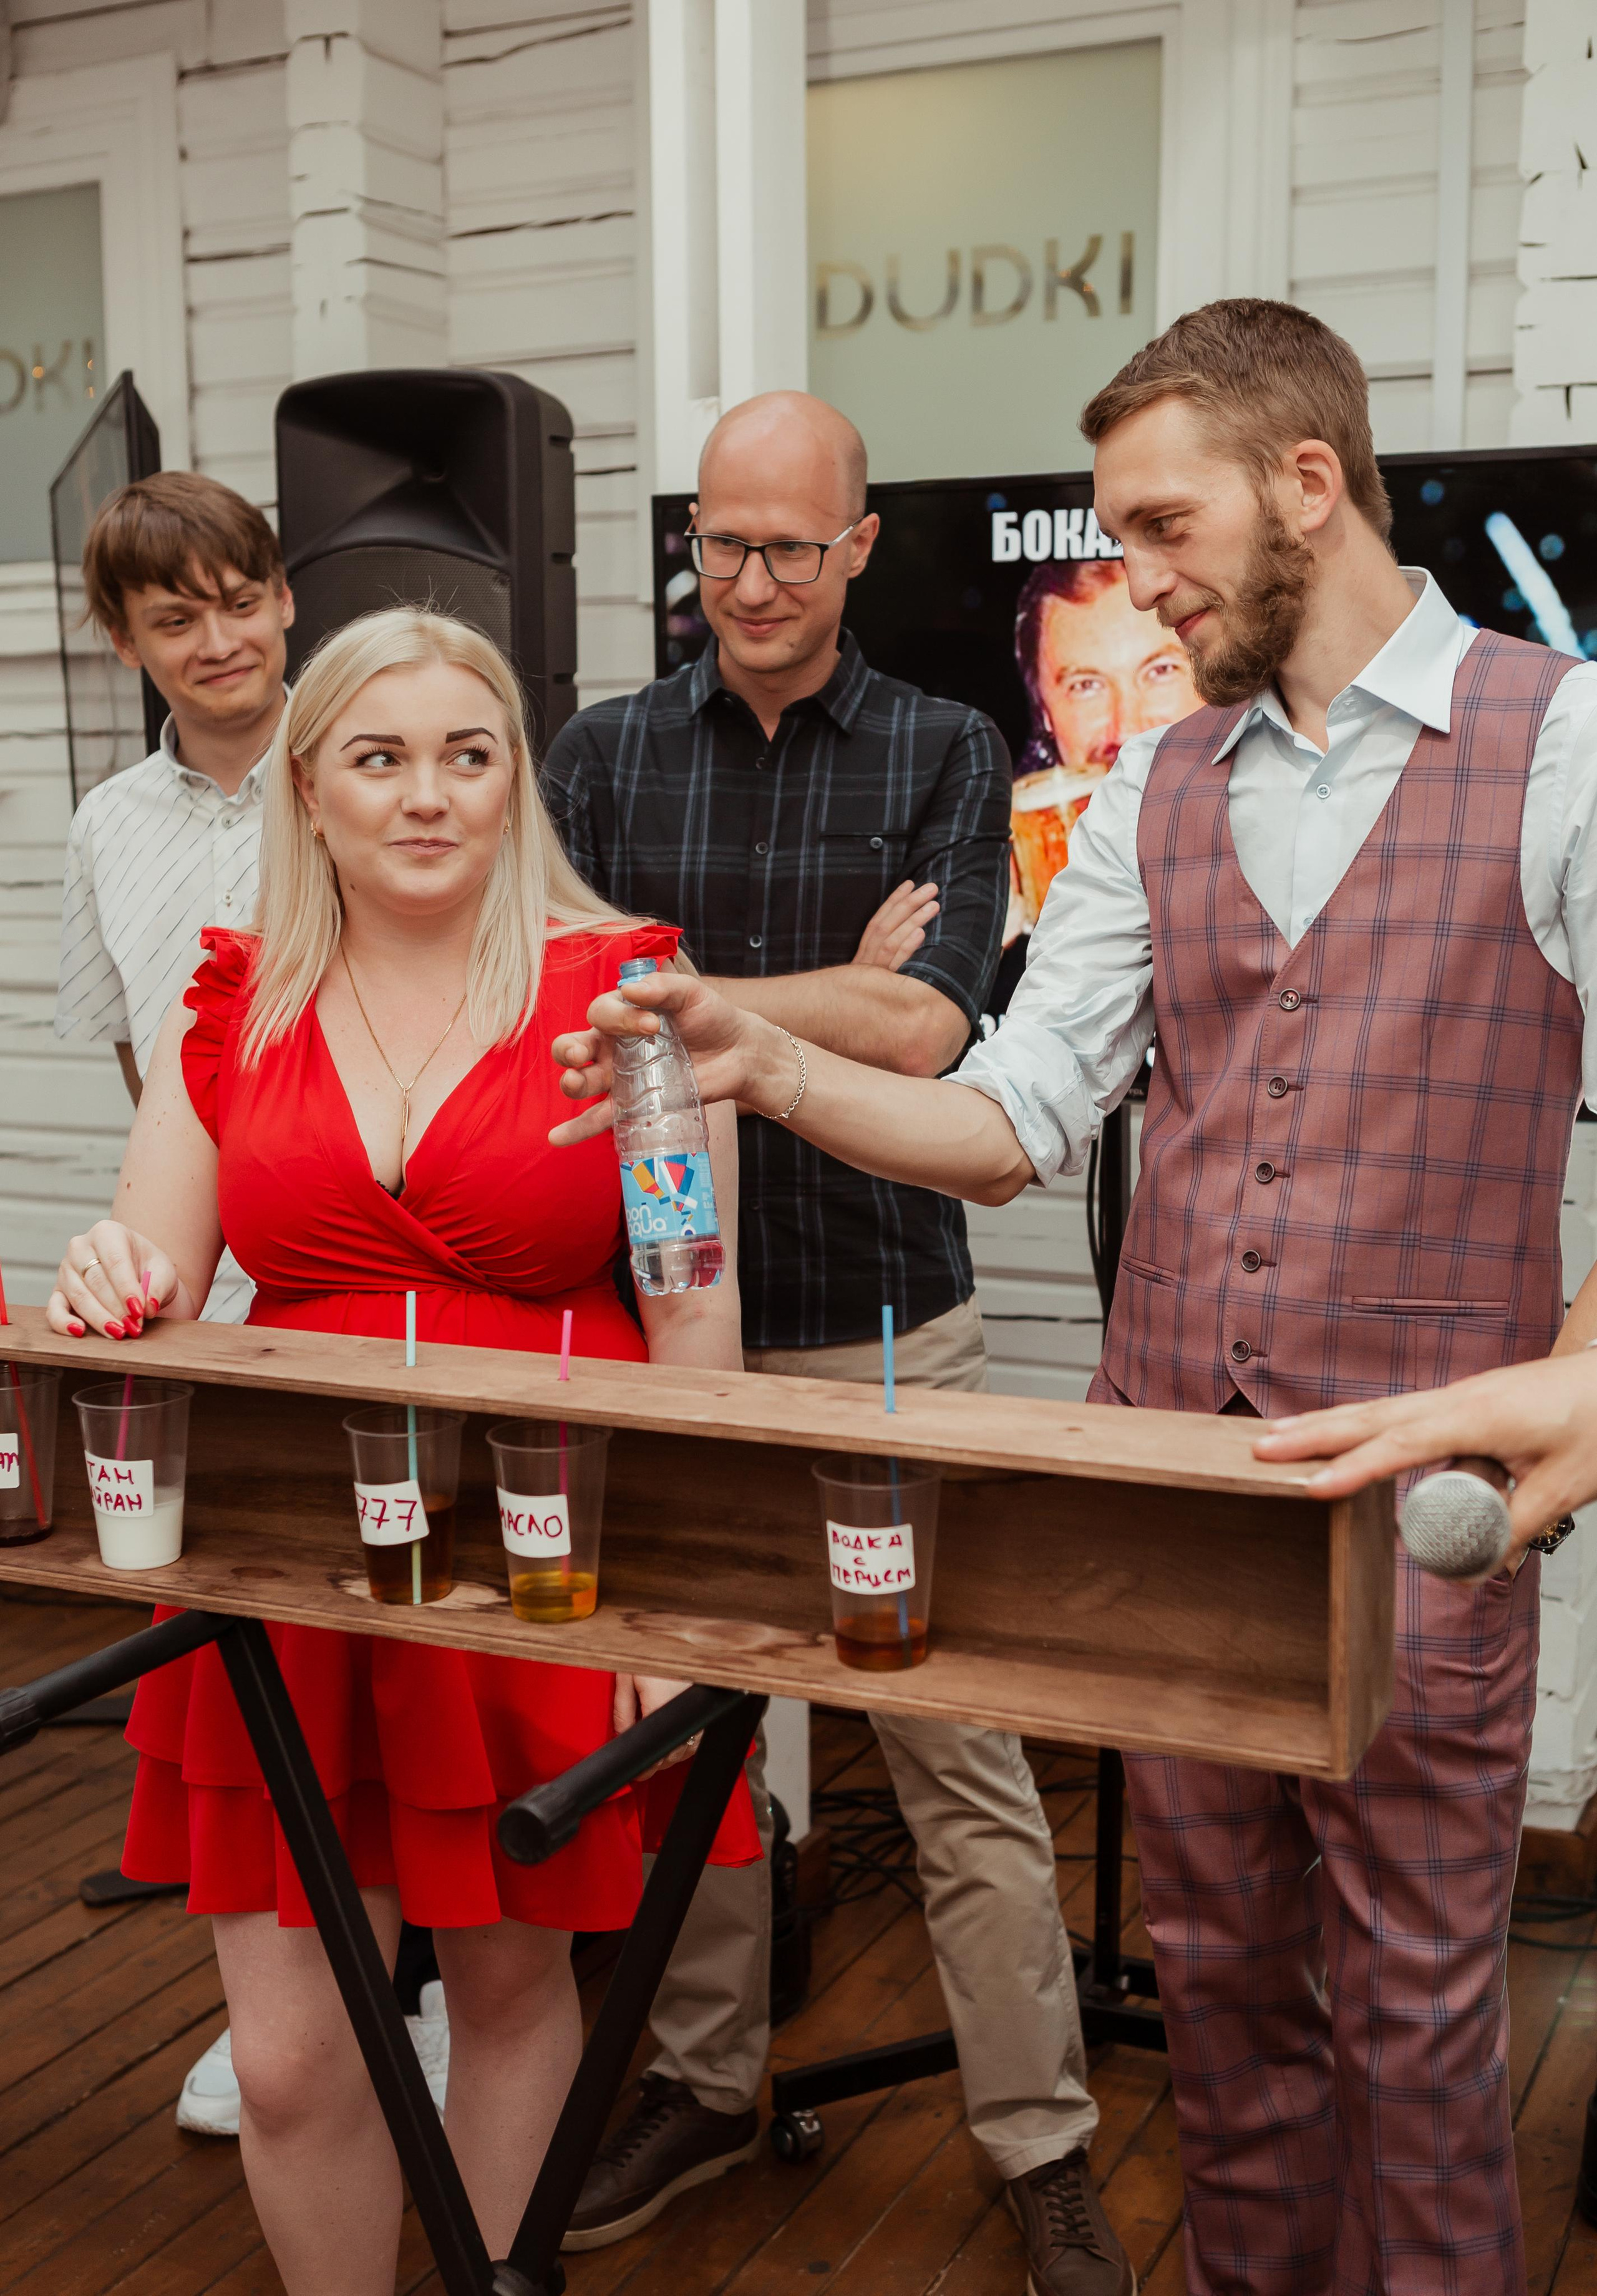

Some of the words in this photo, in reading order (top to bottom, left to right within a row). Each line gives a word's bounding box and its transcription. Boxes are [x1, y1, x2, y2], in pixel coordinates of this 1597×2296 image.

[815, 231, 1134, 341] DUDKI
[87, 1460, 133, 1485] ТАН
[356, 1490, 417, 1532] 777
[832, 1530, 903, 1551] ВОДКА
